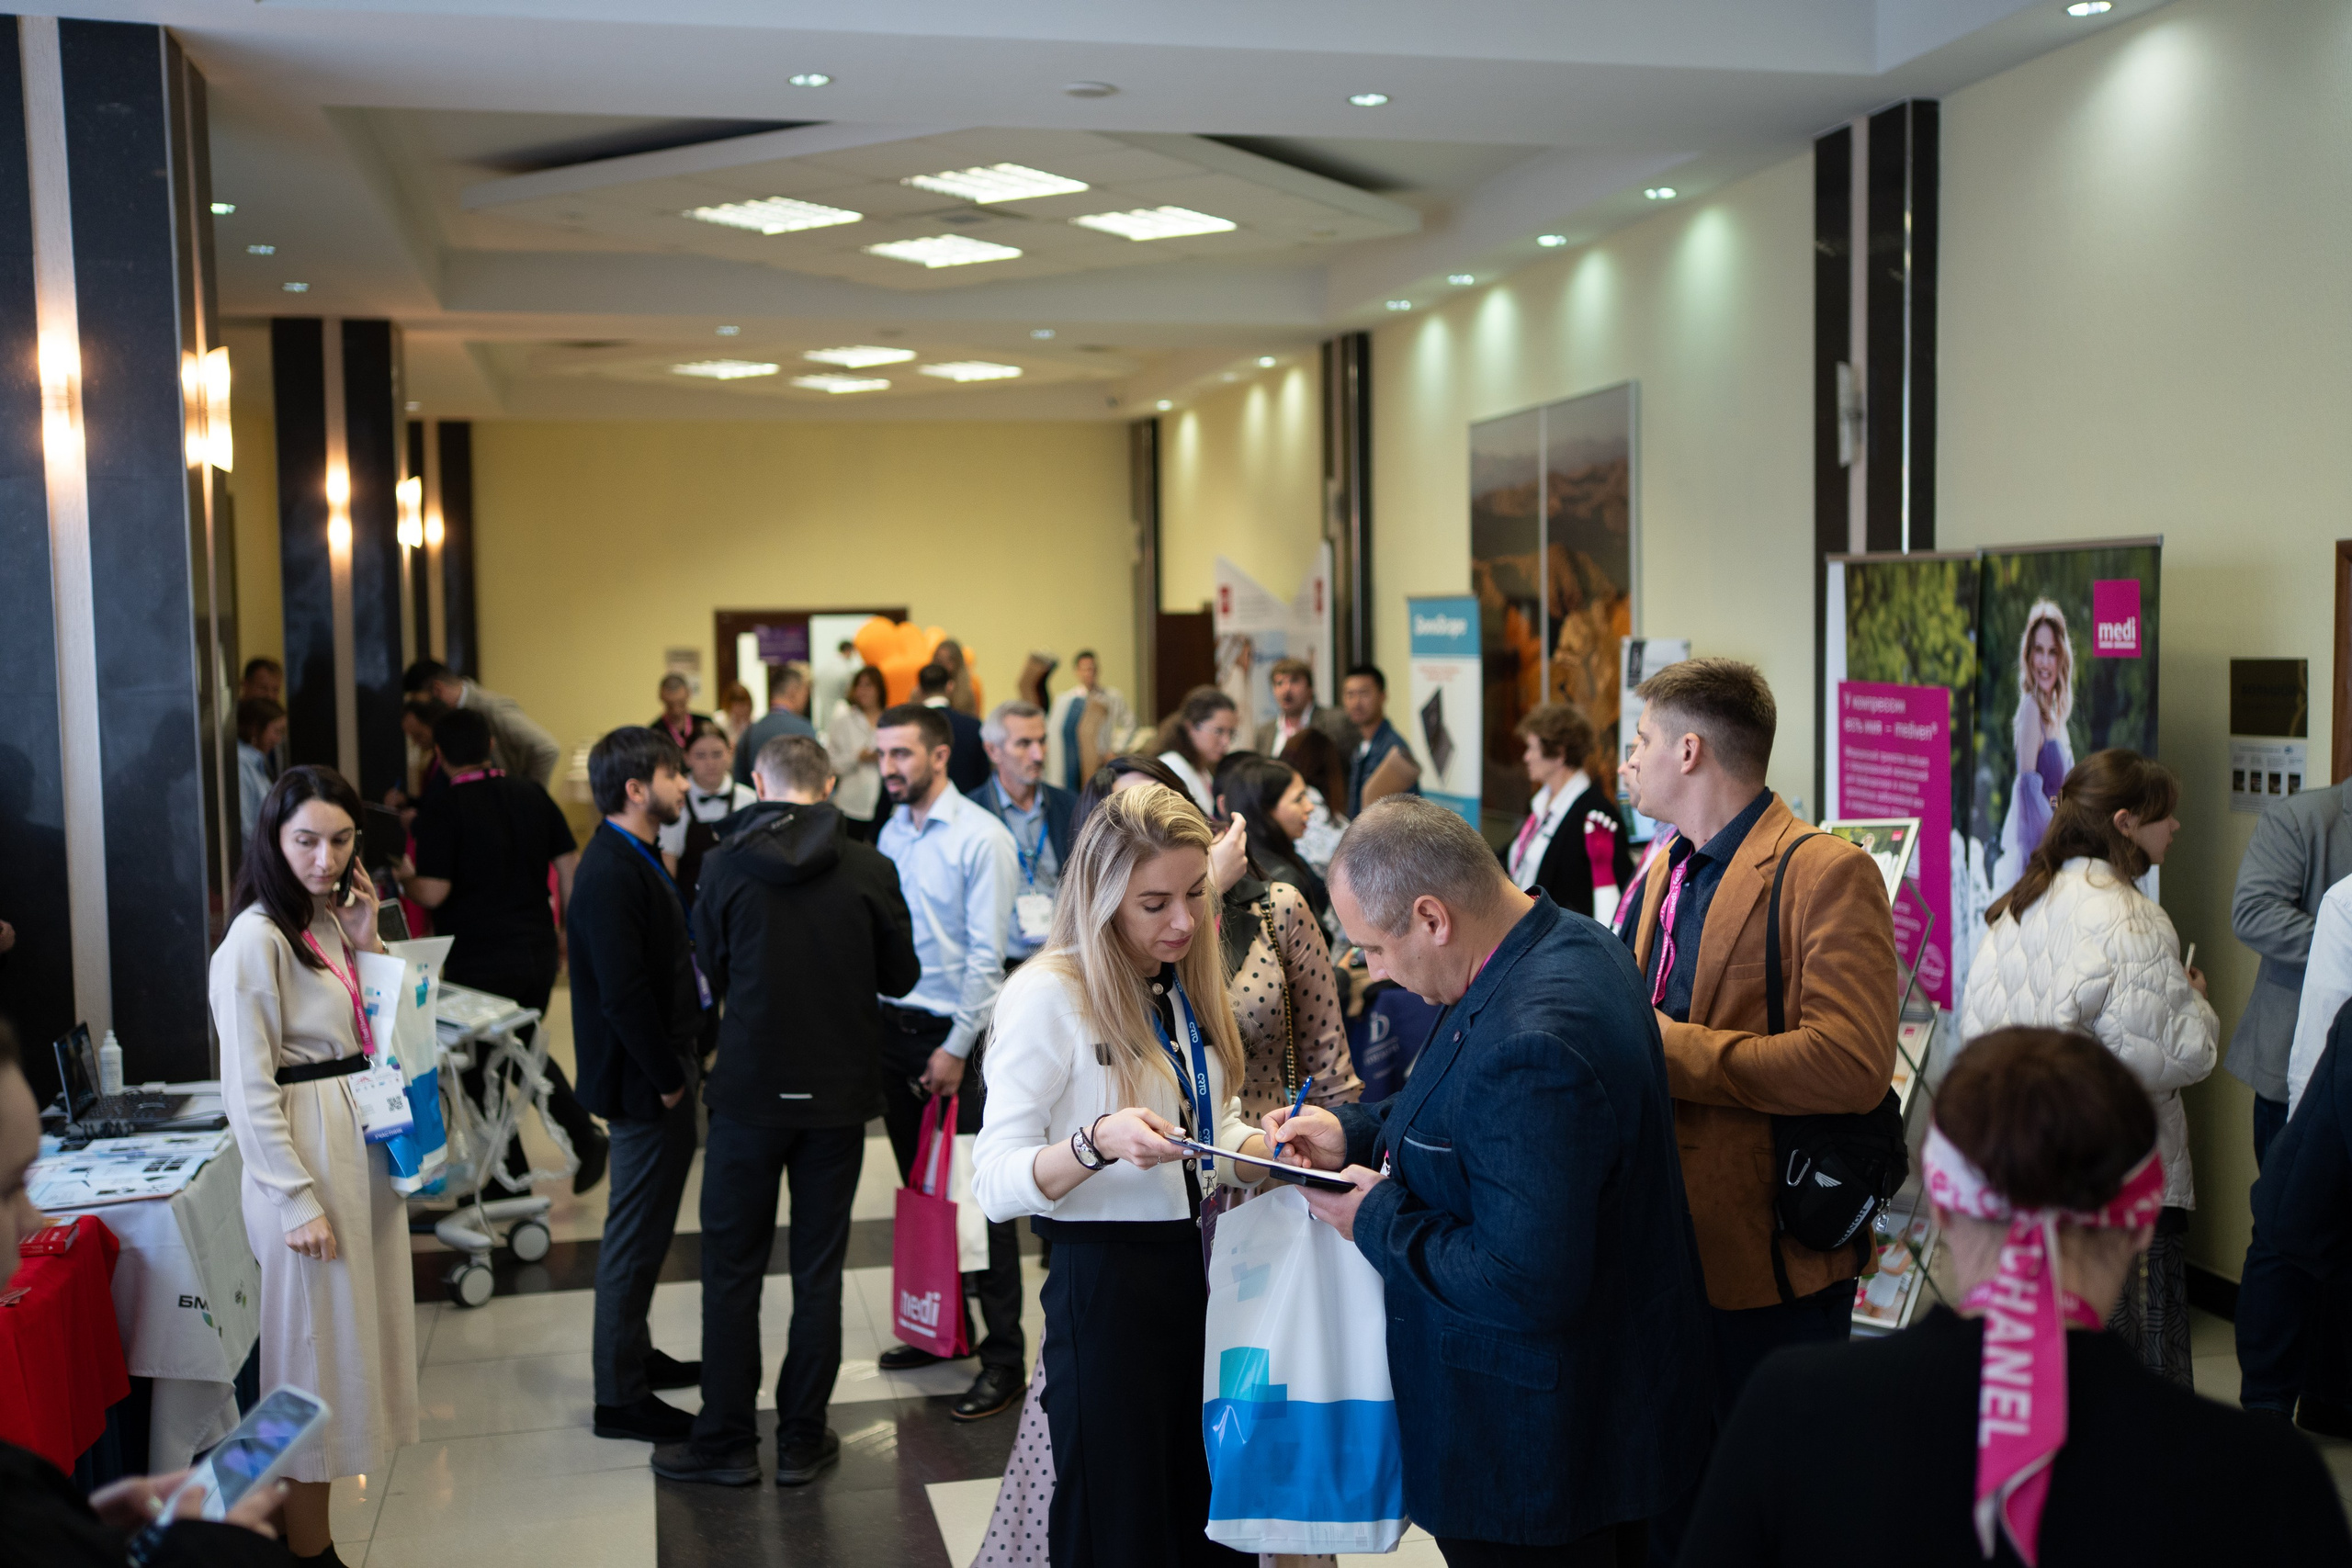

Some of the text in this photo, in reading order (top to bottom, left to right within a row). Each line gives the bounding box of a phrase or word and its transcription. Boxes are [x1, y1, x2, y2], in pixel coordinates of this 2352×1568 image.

[2098, 616, 2136, 641] medi
[1197, 1072, 1206, 1096] CRTO
[899, 1289, 942, 1327] medi
[1978, 1242, 2044, 1449] CHANEL
